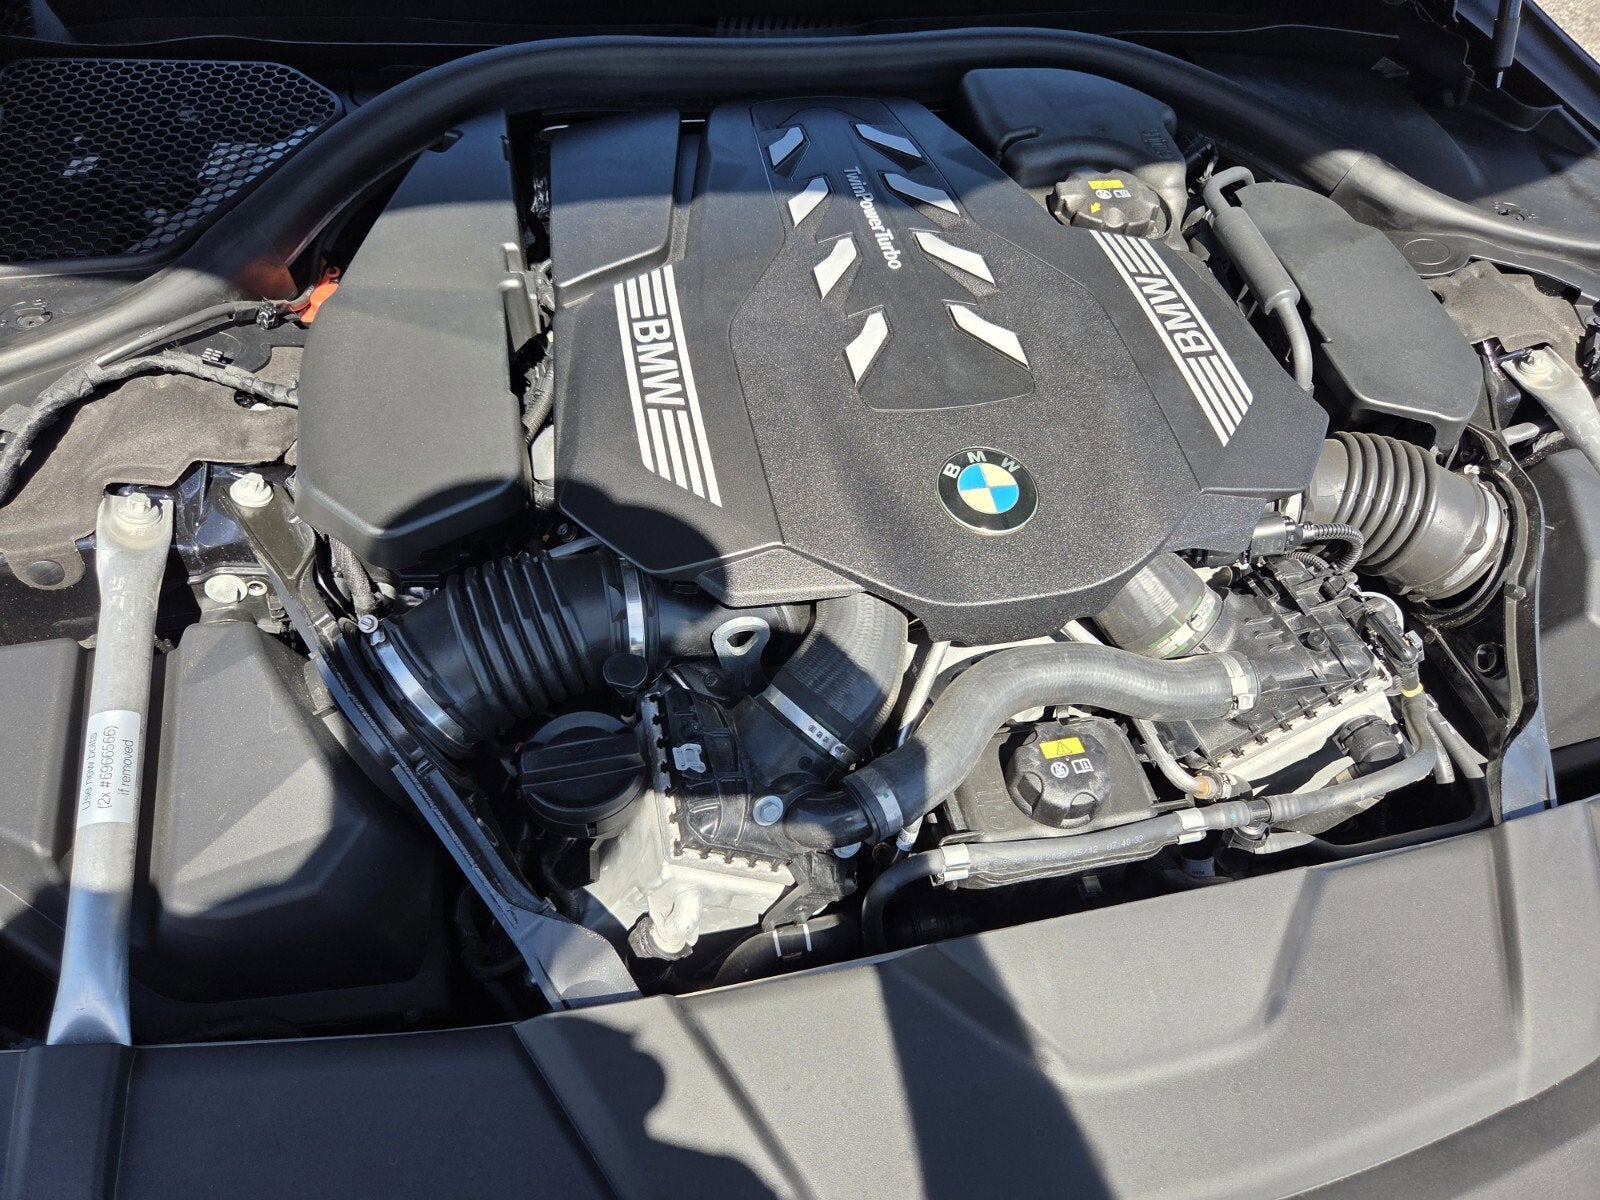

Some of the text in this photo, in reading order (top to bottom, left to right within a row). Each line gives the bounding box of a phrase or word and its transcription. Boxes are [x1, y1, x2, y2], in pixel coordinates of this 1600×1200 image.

[843, 166, 902, 270] TwinPowerTurbo
[1134, 276, 1213, 354] BMW
[632, 318, 686, 406] BMW
[942, 450, 1021, 479] BMW
[82, 732, 98, 811] Use new bolts
[97, 725, 119, 809] (2x #6966566)
[118, 739, 134, 796] if removed
